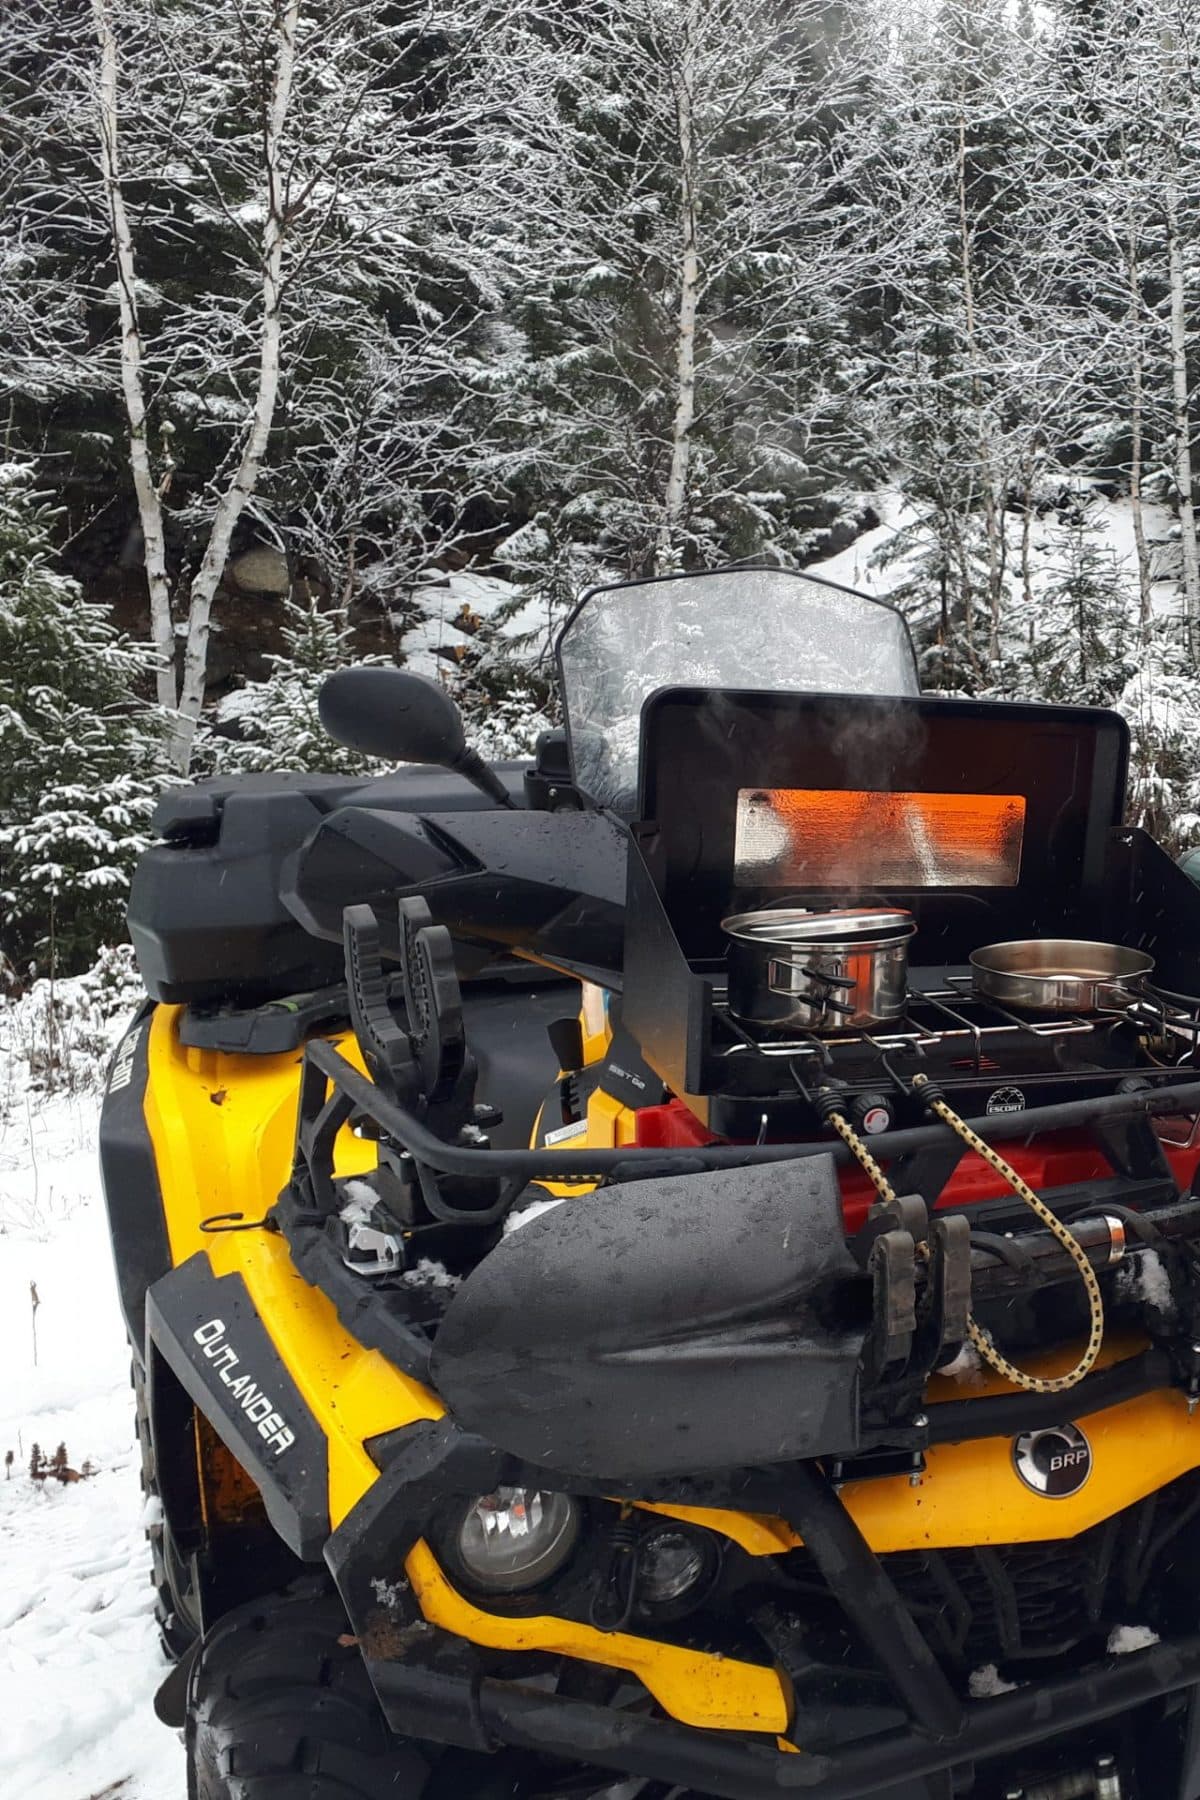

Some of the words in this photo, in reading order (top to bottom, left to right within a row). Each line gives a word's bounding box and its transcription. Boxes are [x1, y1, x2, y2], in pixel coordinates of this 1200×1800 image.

[989, 1104, 1022, 1113] ESCORT
[193, 1319, 295, 1455] OUTLANDER
[1050, 1450, 1087, 1472] BRP
